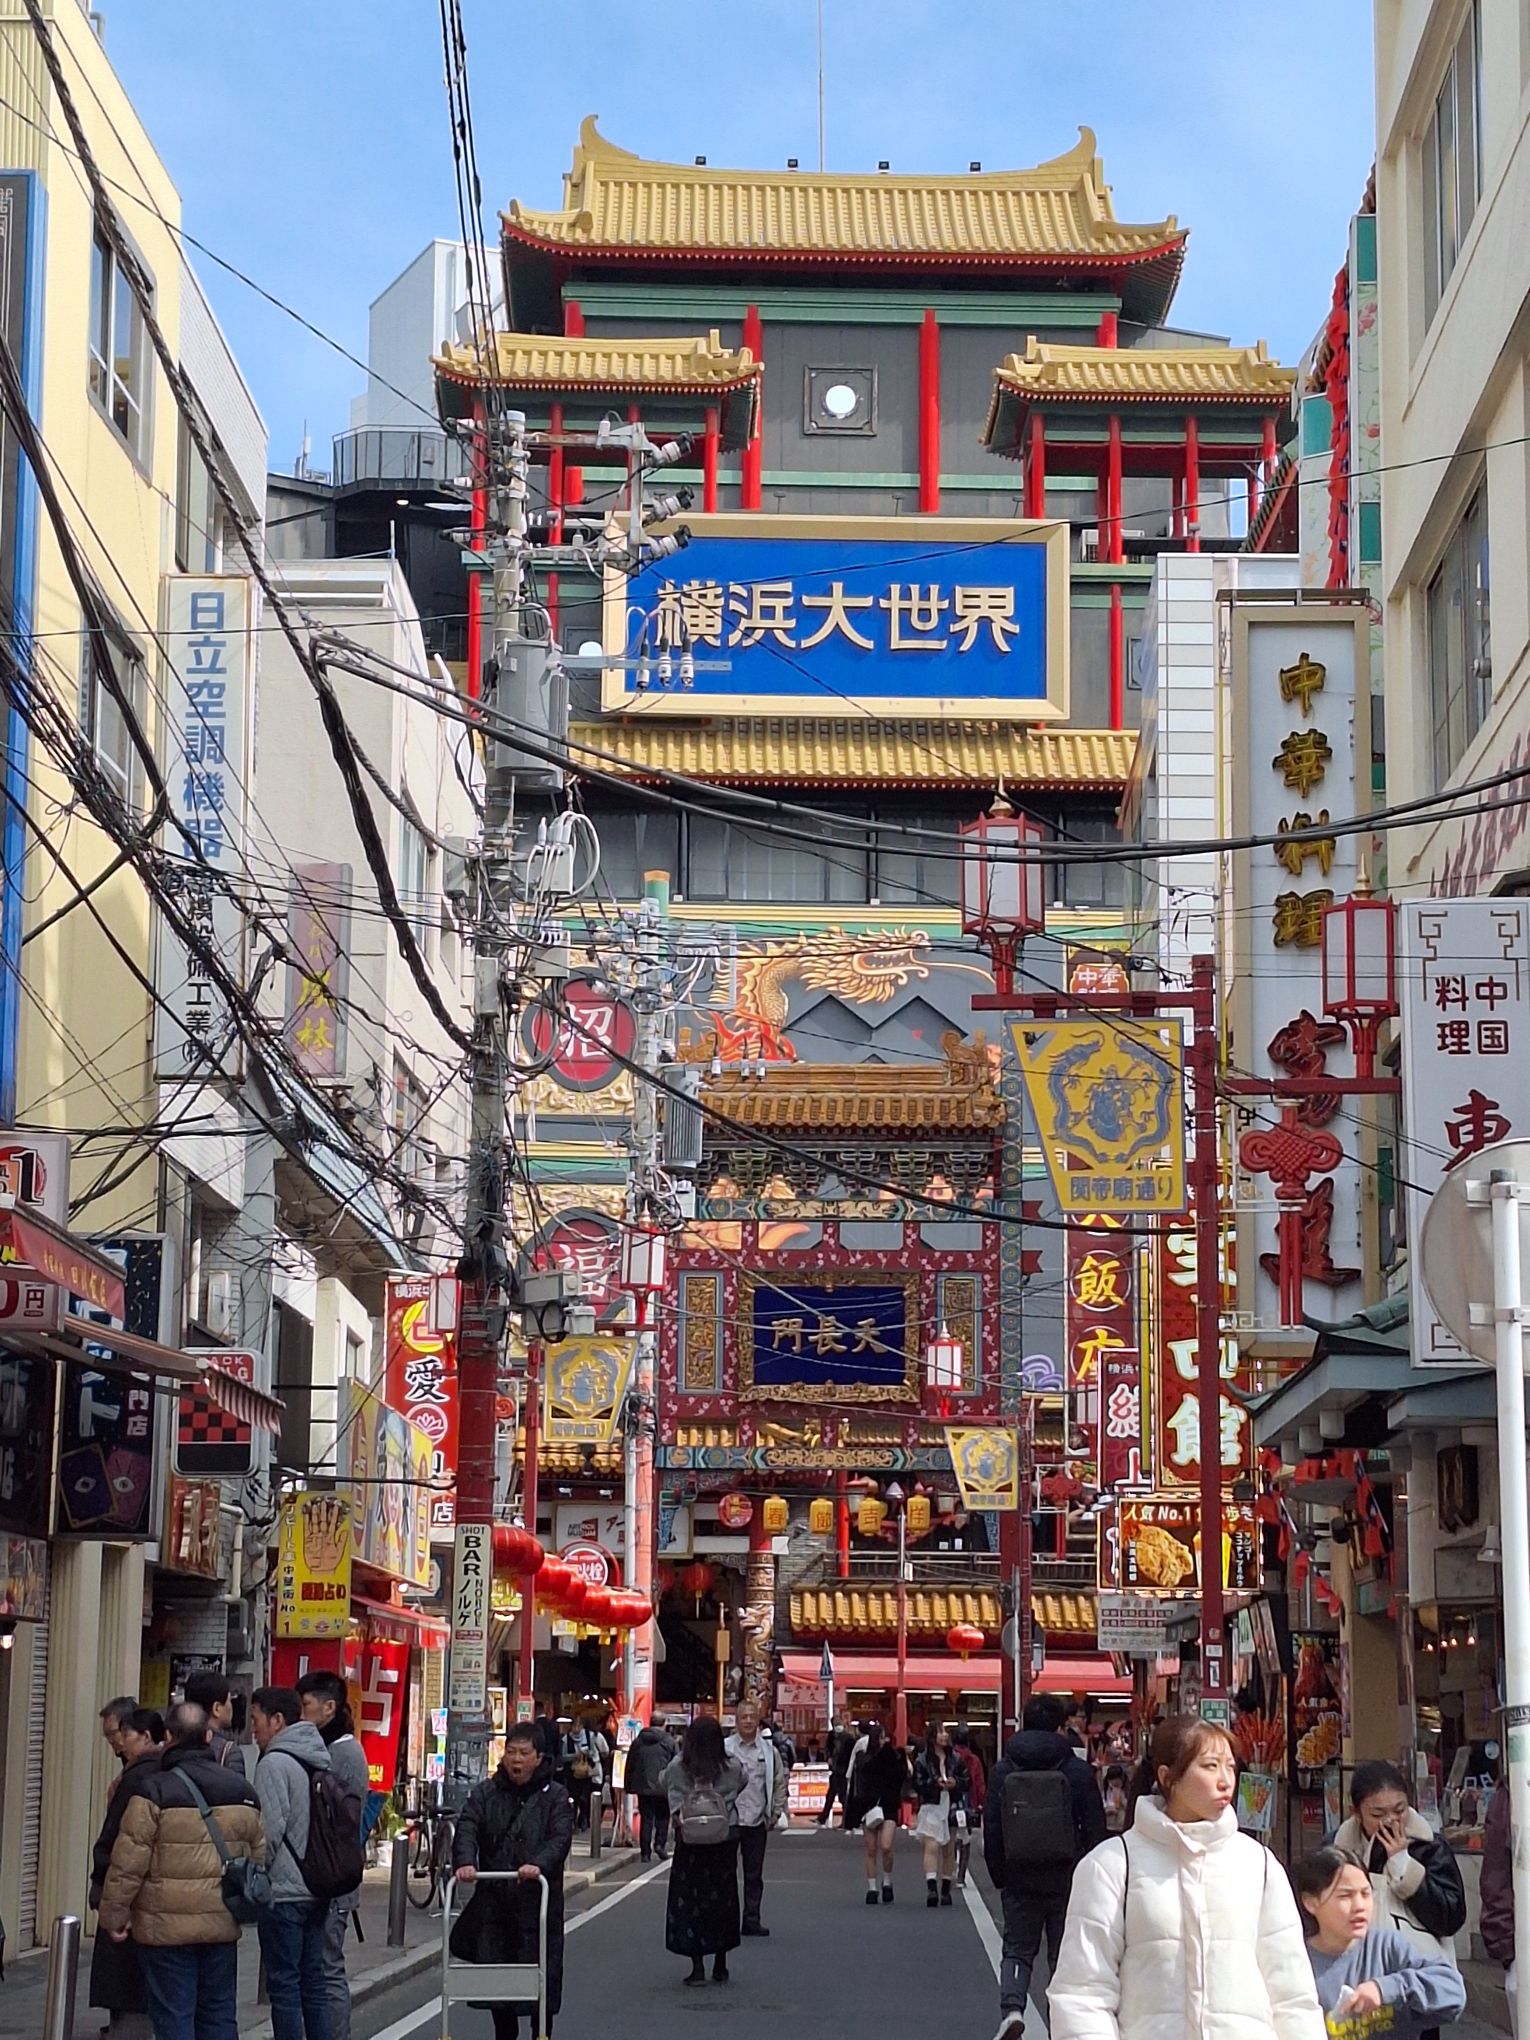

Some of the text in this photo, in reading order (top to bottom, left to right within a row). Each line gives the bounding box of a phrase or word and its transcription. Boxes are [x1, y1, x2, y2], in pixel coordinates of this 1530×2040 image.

[655, 580, 1020, 654] 横浜大世界
[183, 592, 228, 859] 日立空調機器
[405, 1357, 449, 1400] 愛
[461, 1526, 485, 1535] SHOT
[1157, 1505, 1191, 1522] No.1
[462, 1536, 482, 1576] BAR
[458, 1579, 471, 1627] ノルゲ
